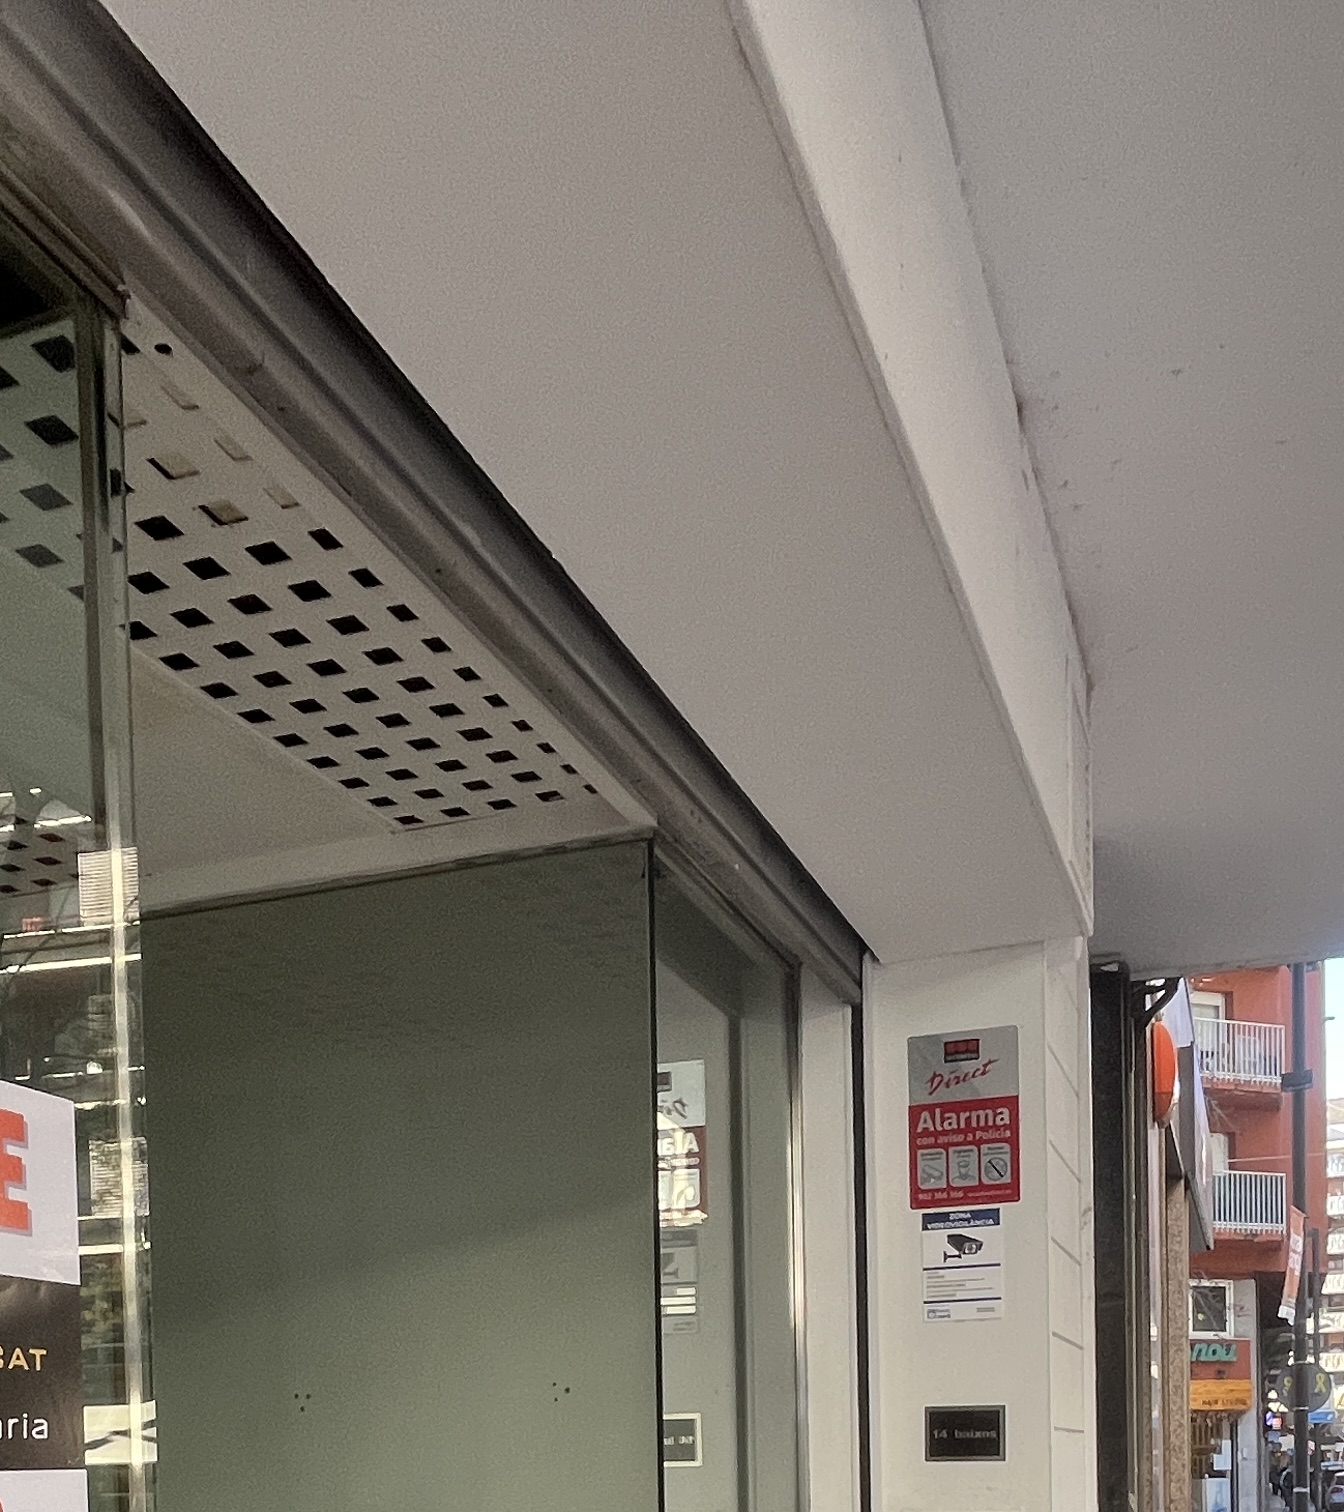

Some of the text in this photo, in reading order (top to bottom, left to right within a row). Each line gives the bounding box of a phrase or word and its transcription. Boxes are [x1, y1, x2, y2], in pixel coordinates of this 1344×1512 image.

[916, 1107, 1010, 1132] Alarma
[916, 1127, 1011, 1146] con aviso a Policía
[933, 1428, 948, 1439] 14
